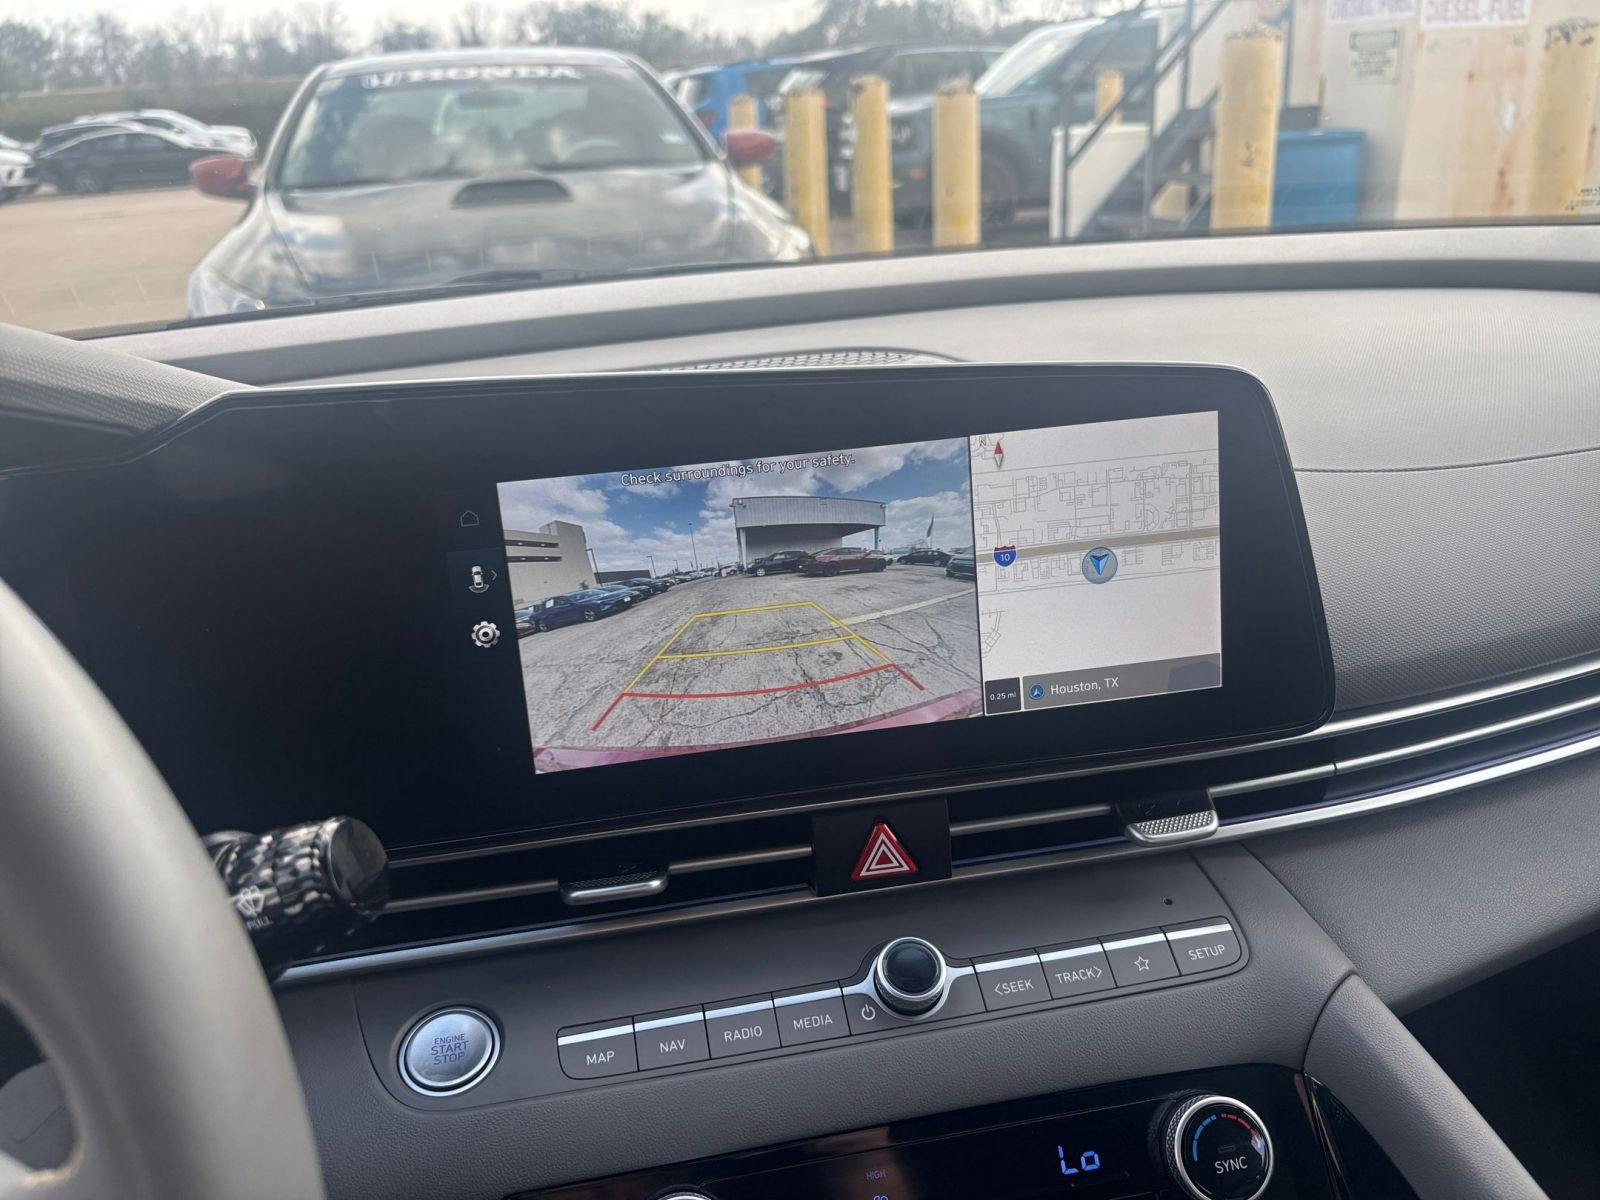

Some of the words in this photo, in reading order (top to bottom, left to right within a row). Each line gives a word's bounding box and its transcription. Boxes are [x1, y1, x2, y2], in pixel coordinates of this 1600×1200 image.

[621, 471, 662, 487] Check
[665, 463, 754, 483] surroundings
[757, 460, 776, 473] for
[779, 458, 808, 473] your
[812, 453, 855, 468] safety.
[1000, 553, 1011, 562] 10
[1050, 680, 1101, 695] Houston,
[1103, 677, 1120, 689] TX
[989, 692, 1006, 701] 0.25
[1007, 690, 1017, 699] mi
[1188, 944, 1226, 961] SETUP
[793, 1014, 833, 1031] MEDIA
[434, 1033, 466, 1045] ENGINE
[723, 1025, 763, 1043] RADIO
[431, 1040, 469, 1056] START
[659, 1039, 686, 1054] NAV
[433, 1051, 466, 1065] STOP
[586, 1050, 616, 1067] MAP
[1214, 1156, 1248, 1175] SYNC
[865, 1168, 888, 1181] HIGH
